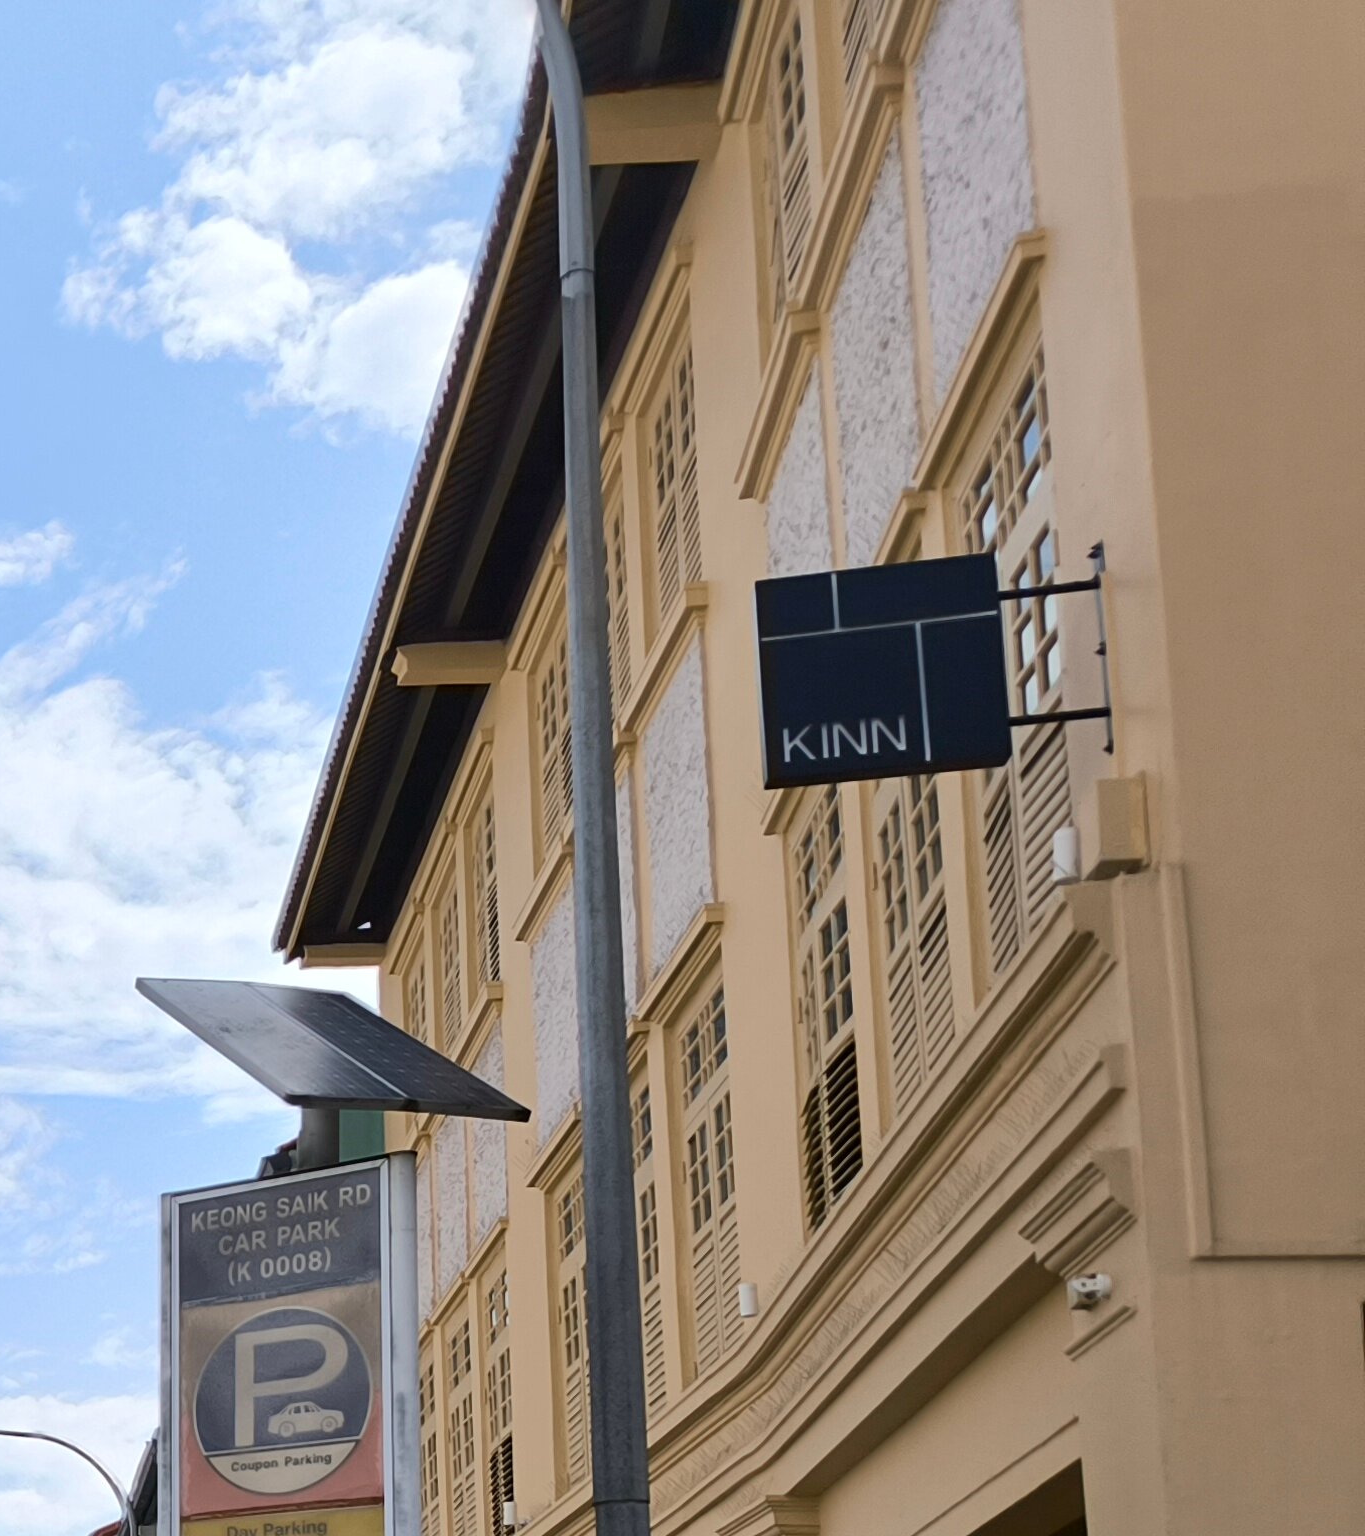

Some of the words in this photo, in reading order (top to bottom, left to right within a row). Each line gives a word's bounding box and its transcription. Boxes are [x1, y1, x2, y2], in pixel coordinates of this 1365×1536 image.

[782, 716, 907, 762] KINN
[191, 1202, 267, 1233] KEONG
[277, 1190, 329, 1218] SAIK
[339, 1184, 371, 1208] RD
[220, 1230, 266, 1255] CAR
[277, 1217, 340, 1246] PARK
[228, 1261, 251, 1286] (K
[260, 1247, 332, 1278] 0008)
[231, 1458, 279, 1473] Coupon
[284, 1453, 332, 1467] Parking
